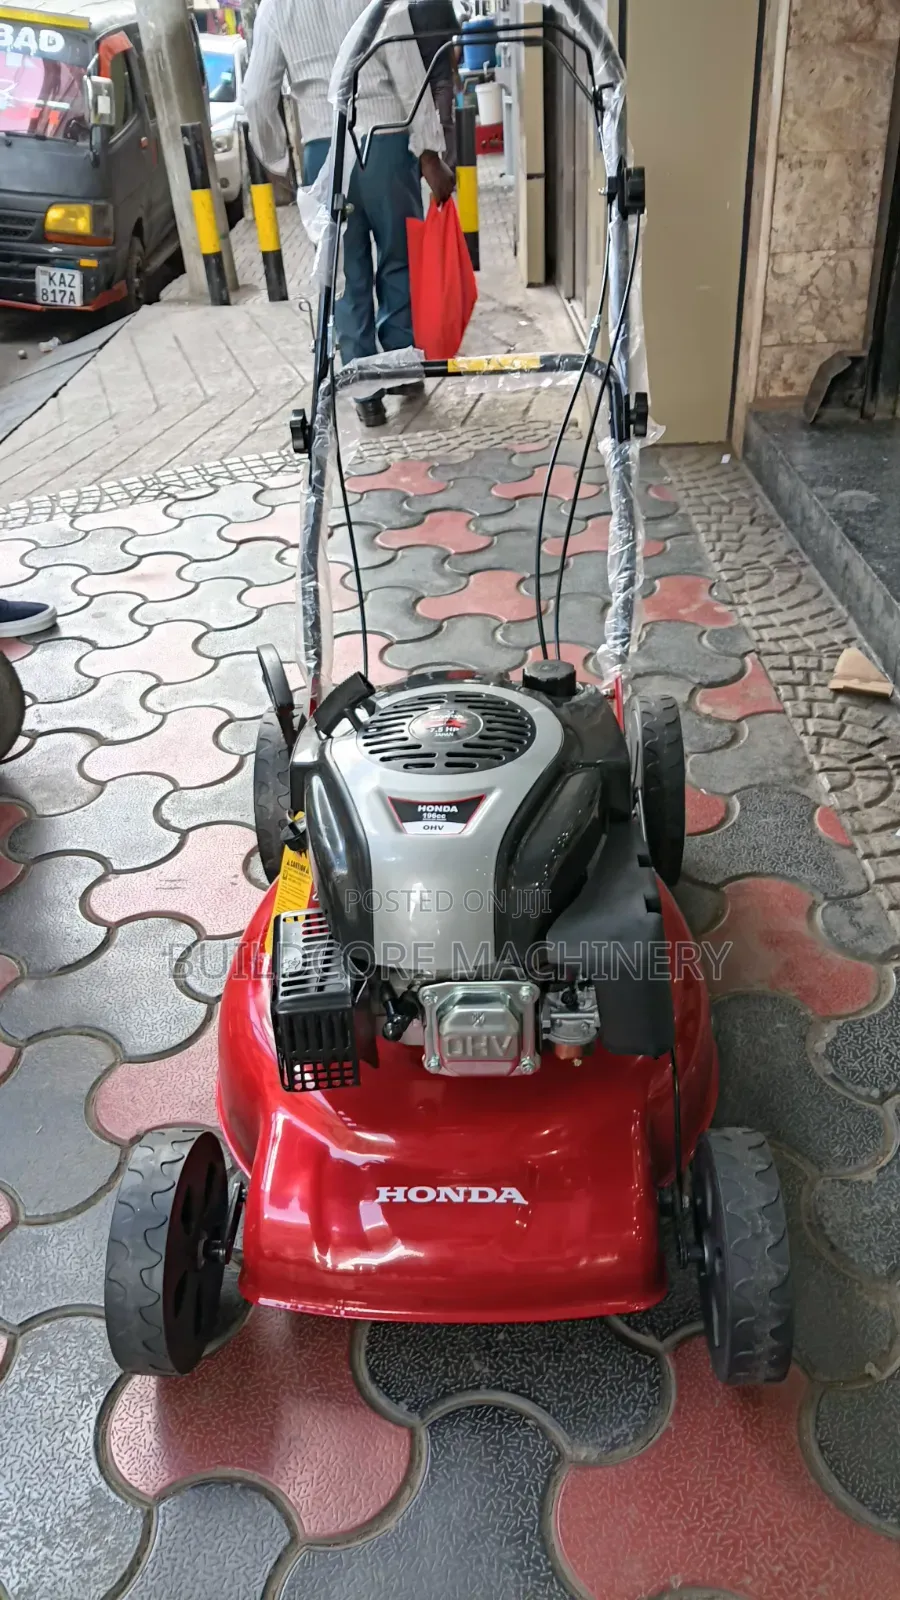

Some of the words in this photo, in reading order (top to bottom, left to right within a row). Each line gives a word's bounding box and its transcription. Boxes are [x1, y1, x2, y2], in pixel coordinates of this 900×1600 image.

[48, 272, 76, 288] KAZ
[41, 288, 76, 304] 817A
[417, 805, 458, 813] HONDA
[442, 1035, 512, 1057] OHV
[374, 1186, 529, 1205] HONDA
